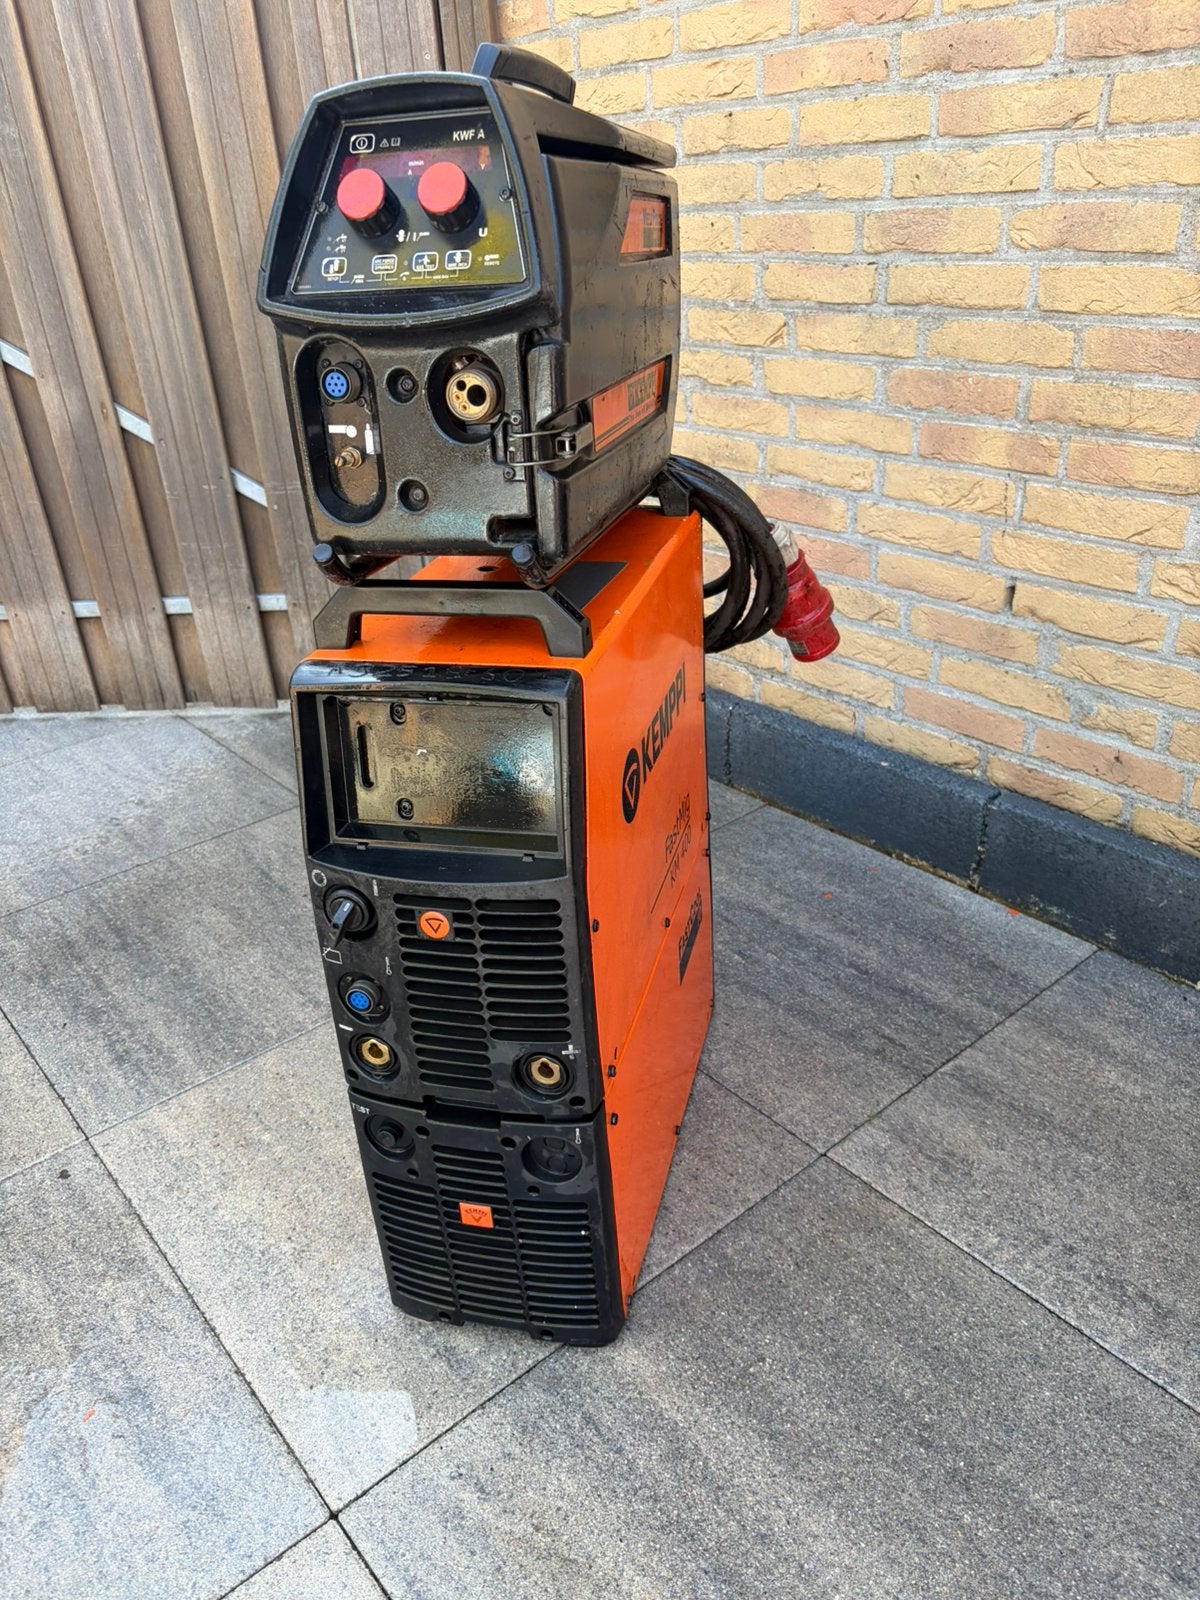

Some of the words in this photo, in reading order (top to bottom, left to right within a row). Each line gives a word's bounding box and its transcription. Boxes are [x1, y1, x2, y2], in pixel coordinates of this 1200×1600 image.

[452, 129, 475, 142] KWF
[476, 128, 486, 140] A
[478, 227, 488, 237] U
[641, 661, 686, 784] KEMPPI
[351, 1102, 371, 1115] TEST
